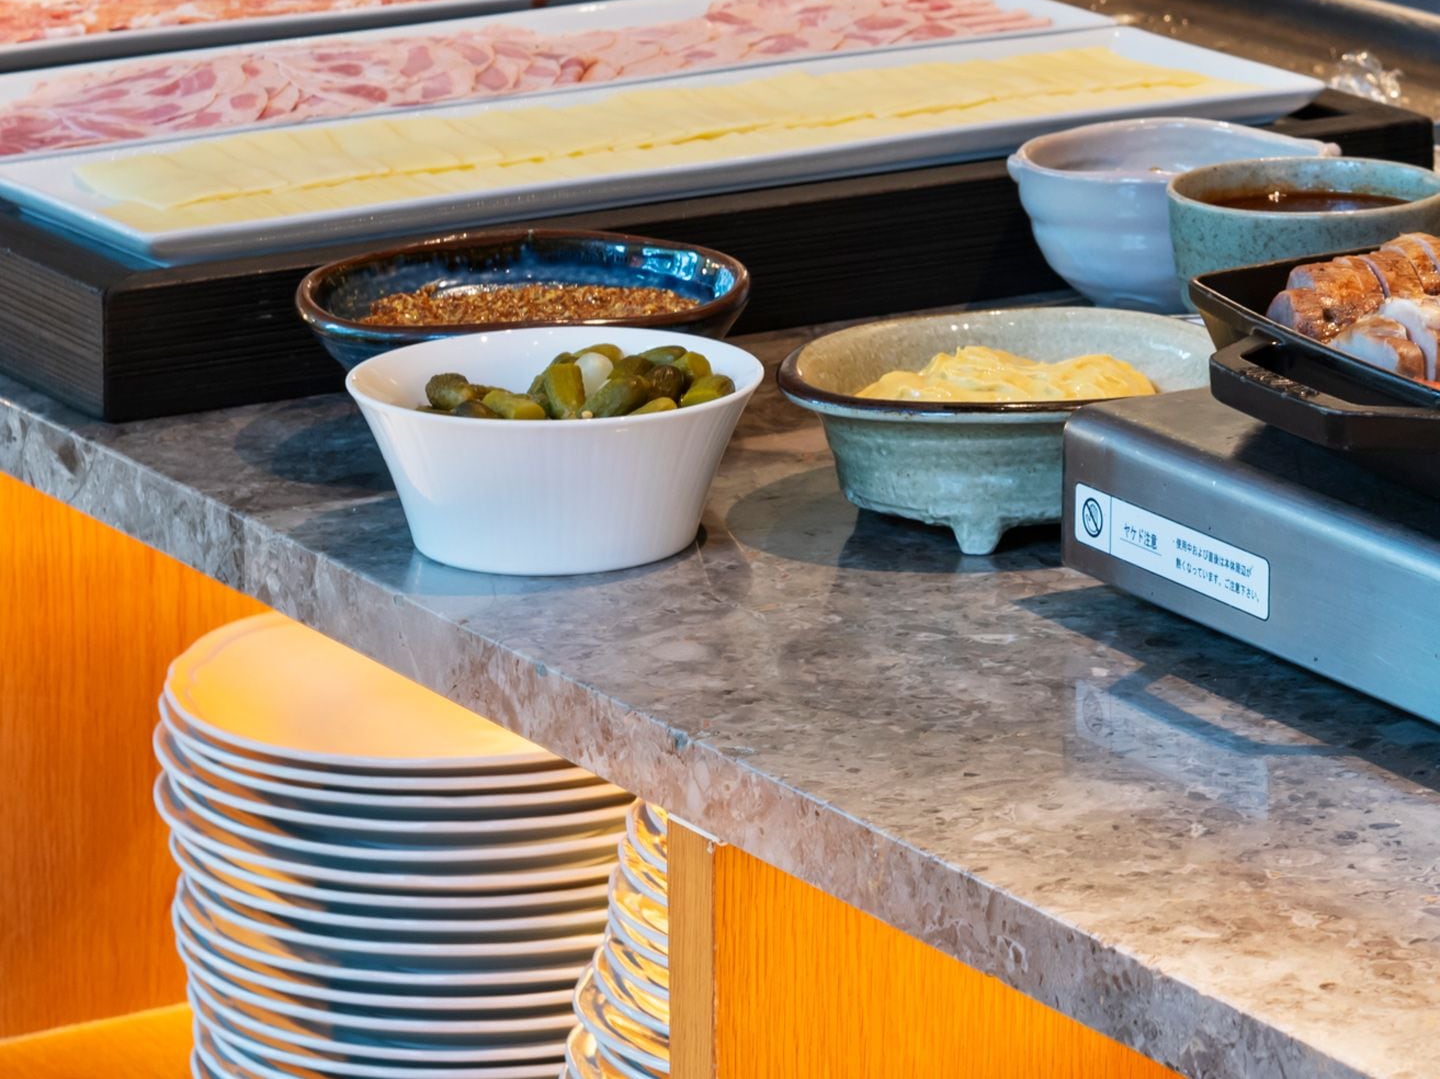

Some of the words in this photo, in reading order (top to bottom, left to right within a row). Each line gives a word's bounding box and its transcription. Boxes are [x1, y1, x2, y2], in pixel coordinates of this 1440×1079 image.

[1123, 522, 1158, 550] ヤケド注意
